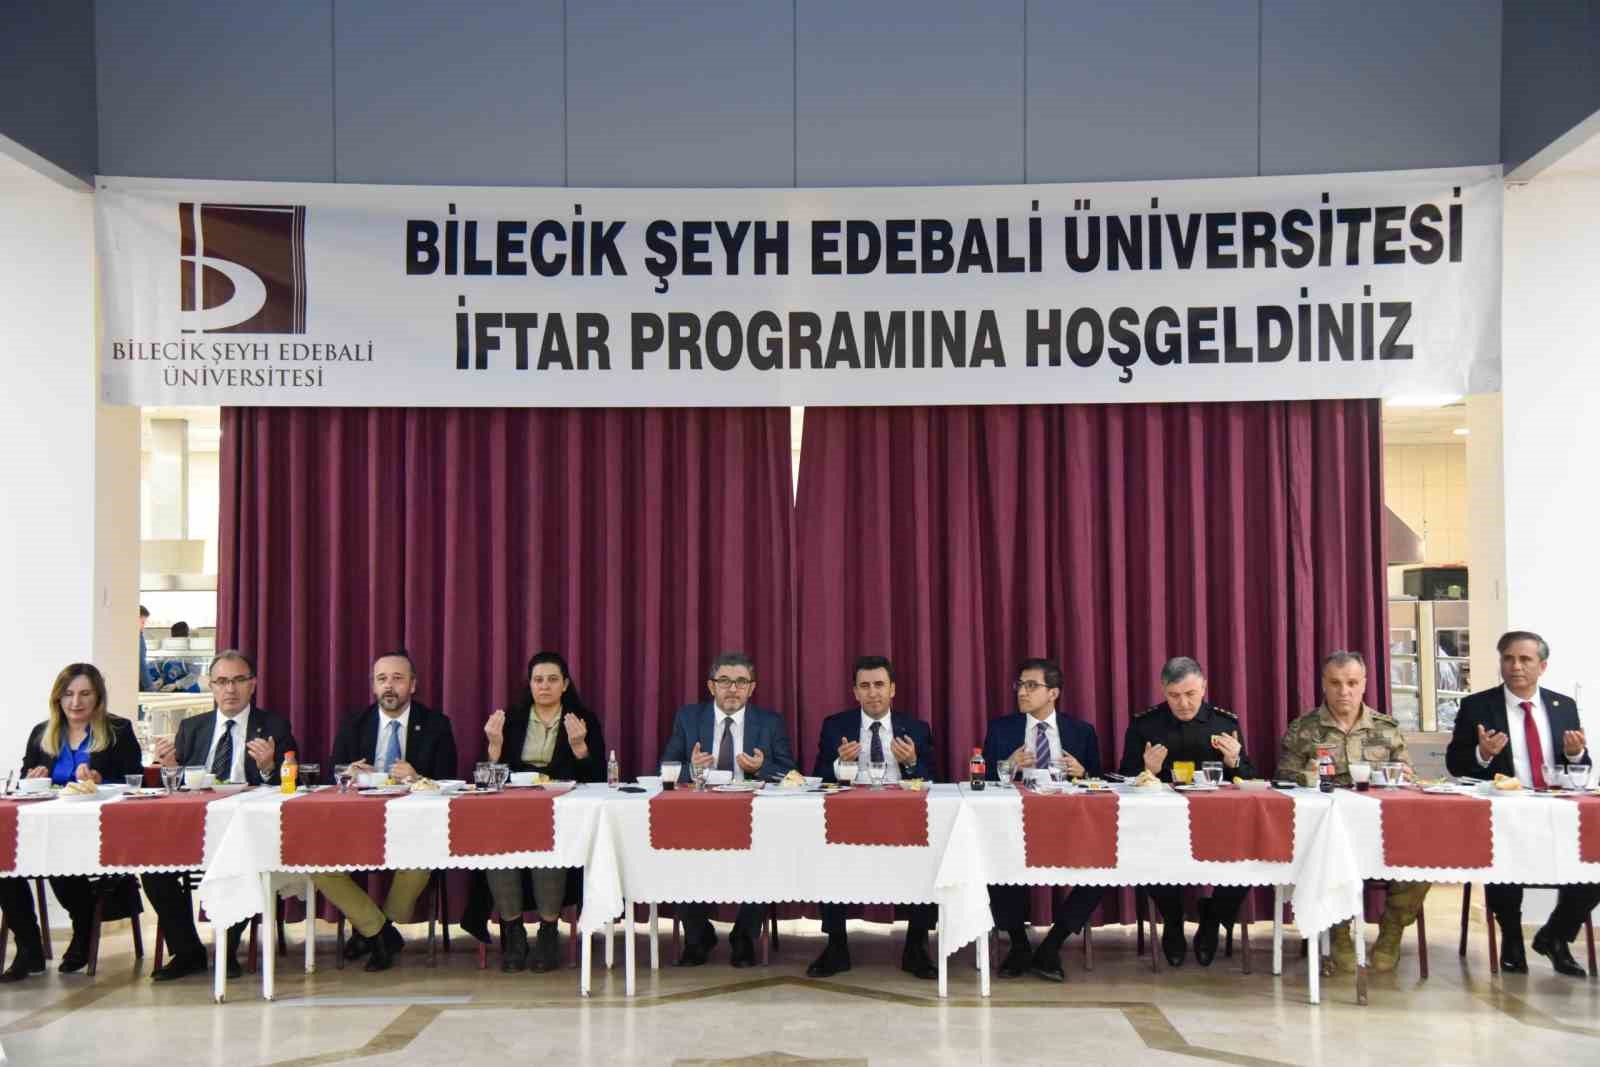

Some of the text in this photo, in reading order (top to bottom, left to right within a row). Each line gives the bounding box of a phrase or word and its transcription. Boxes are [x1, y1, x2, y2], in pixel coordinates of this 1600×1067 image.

[406, 187, 1463, 293] BİLECİK ŞEYH EDEBALİ ÜNİVERSİTESİ
[112, 339, 374, 366] BİLECİK ŞEYH EDEBALİ
[456, 285, 1413, 384] İFTAR PROGRAMINA HOŞGELDİNİZ
[164, 365, 324, 388] ÜNİVERSİTESİ
